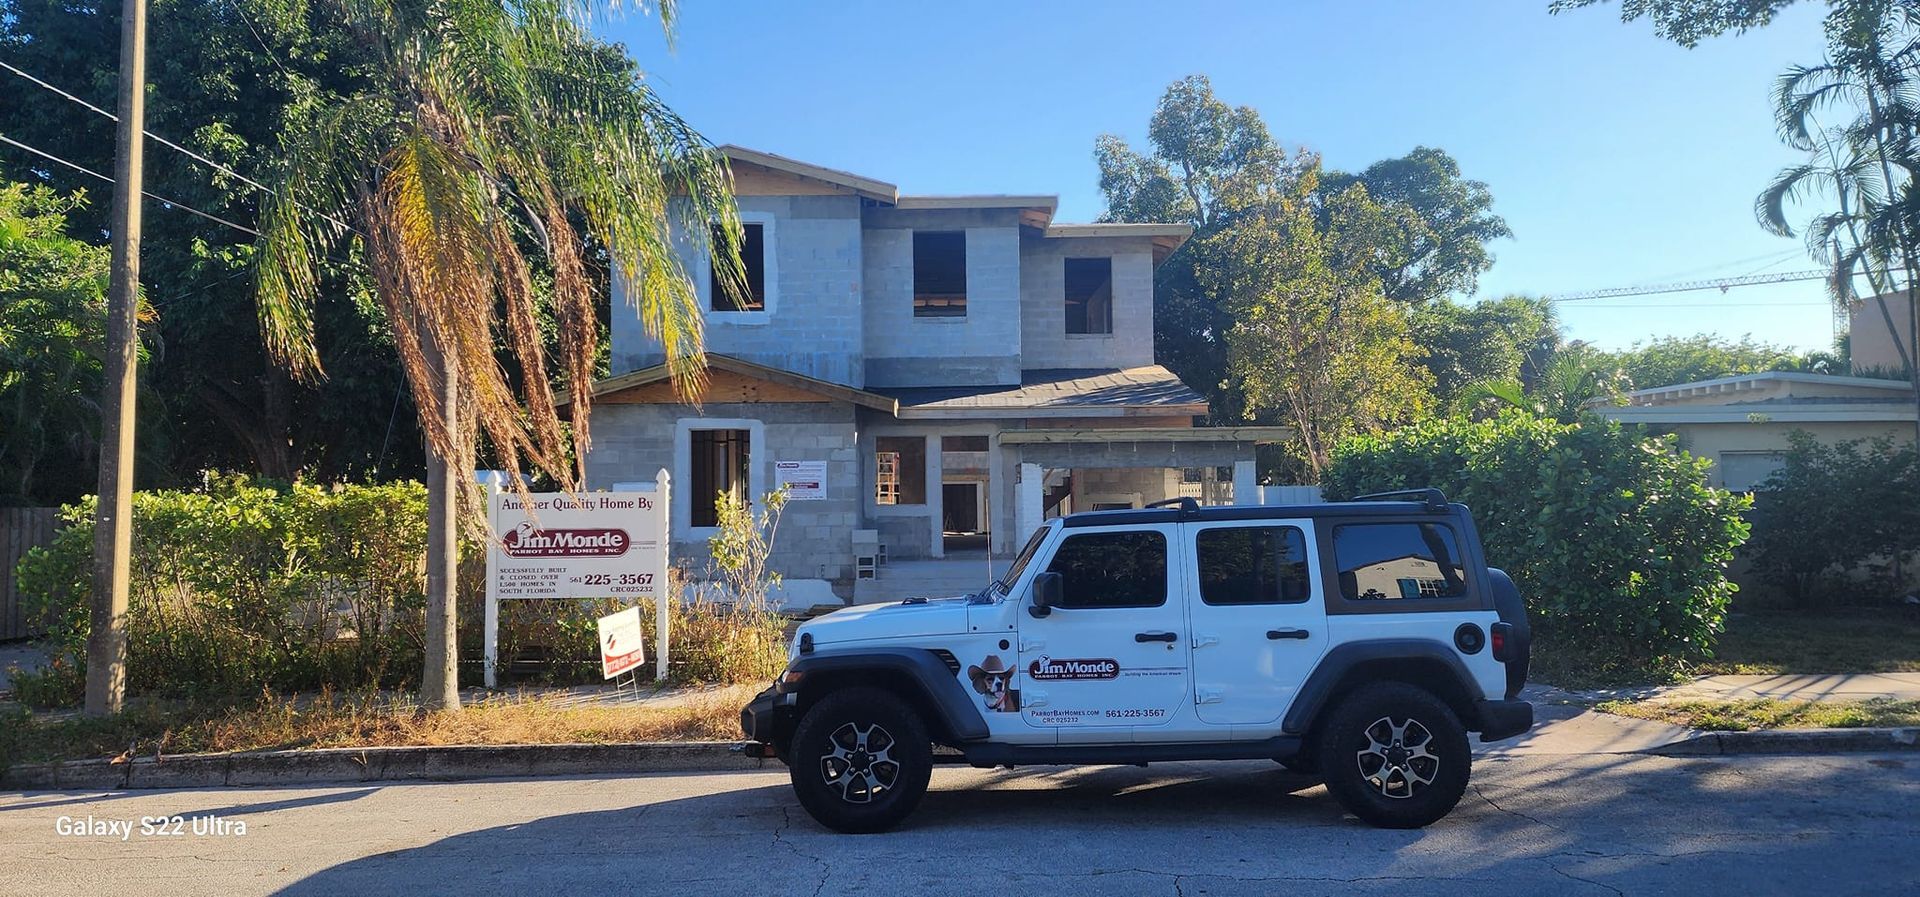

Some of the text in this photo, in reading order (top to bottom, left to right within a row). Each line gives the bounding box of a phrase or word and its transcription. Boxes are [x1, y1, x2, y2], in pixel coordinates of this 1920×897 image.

[600, 498, 634, 509] Home
[638, 497, 654, 511] By
[510, 528, 623, 549] Jim Monde
[584, 573, 653, 586] 225-3567
[1034, 660, 1115, 674] Jim Monde
[1105, 709, 1165, 718] 561-225-3567
